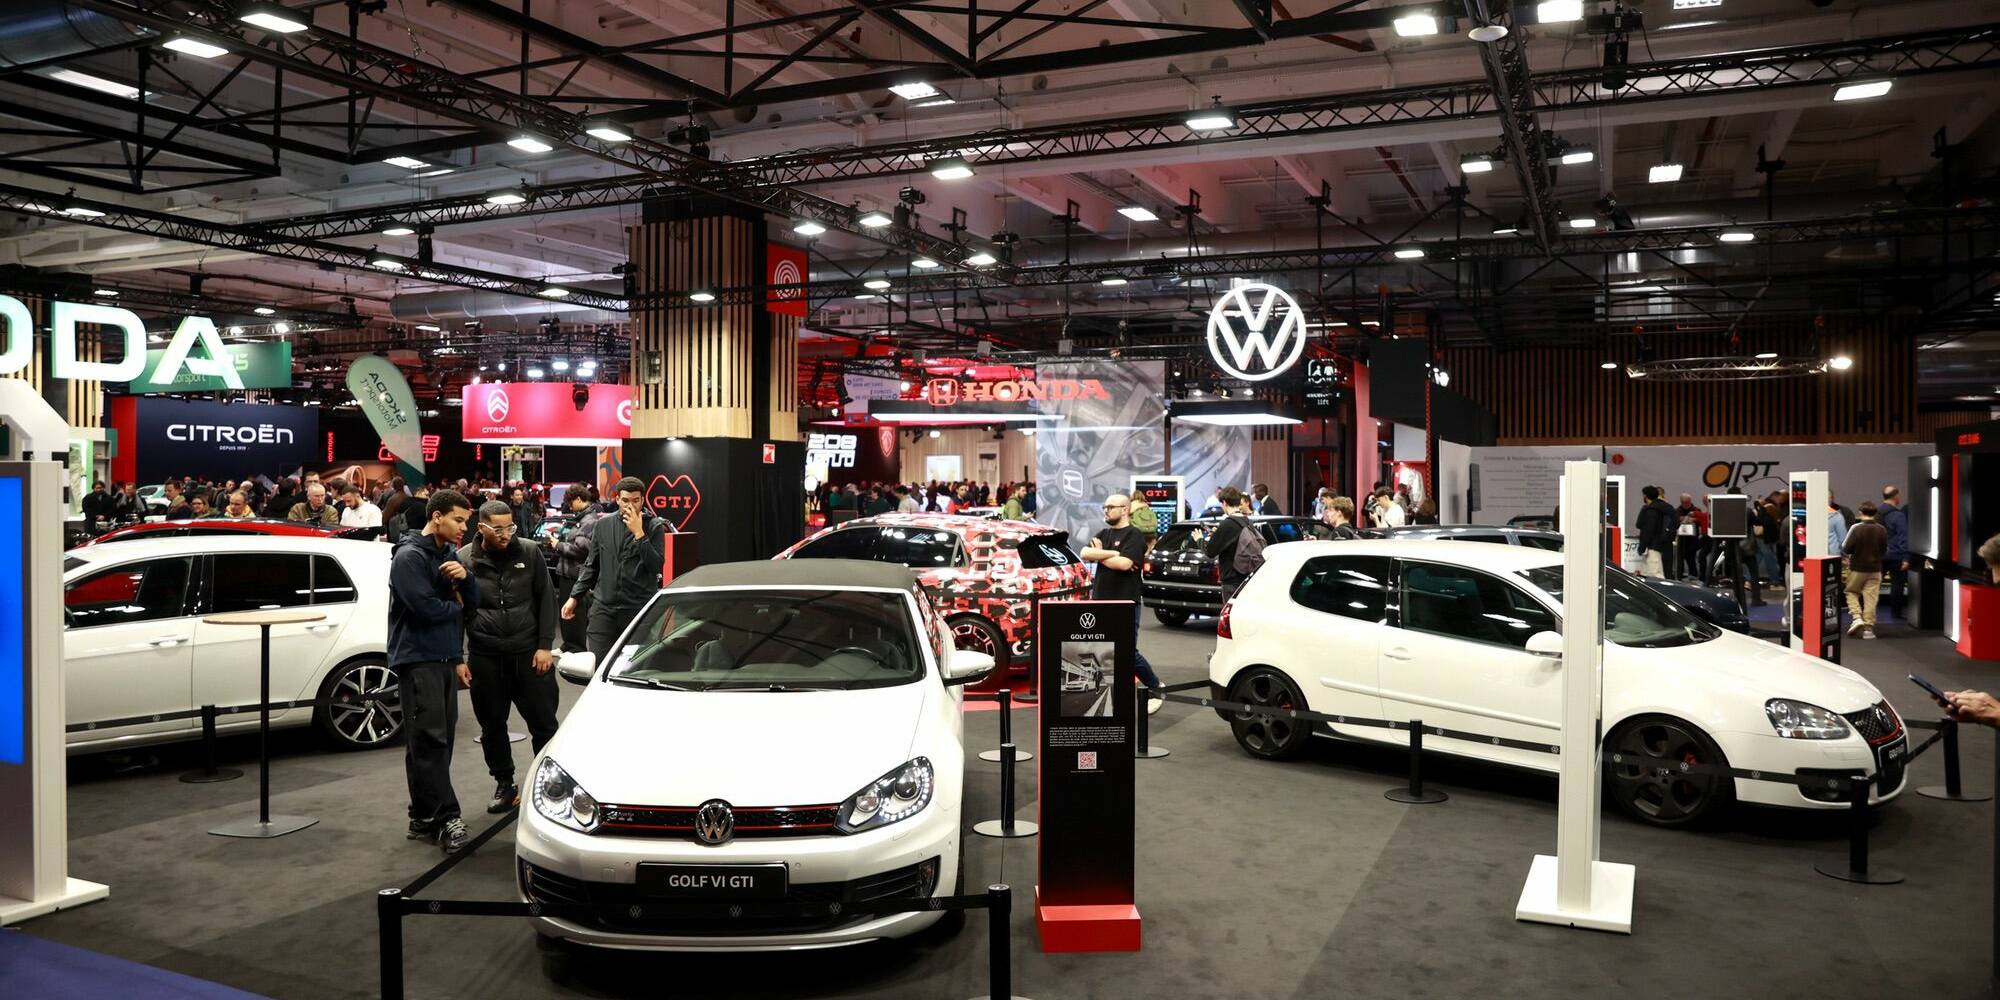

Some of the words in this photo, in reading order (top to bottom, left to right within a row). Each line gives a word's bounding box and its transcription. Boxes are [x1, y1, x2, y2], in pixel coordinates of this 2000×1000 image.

[963, 378, 1110, 401] HONDA
[167, 424, 294, 444] CITROËN
[654, 497, 692, 508] GTI
[669, 874, 708, 888] GOLF
[711, 874, 726, 888] VI
[729, 874, 754, 888] GTI
